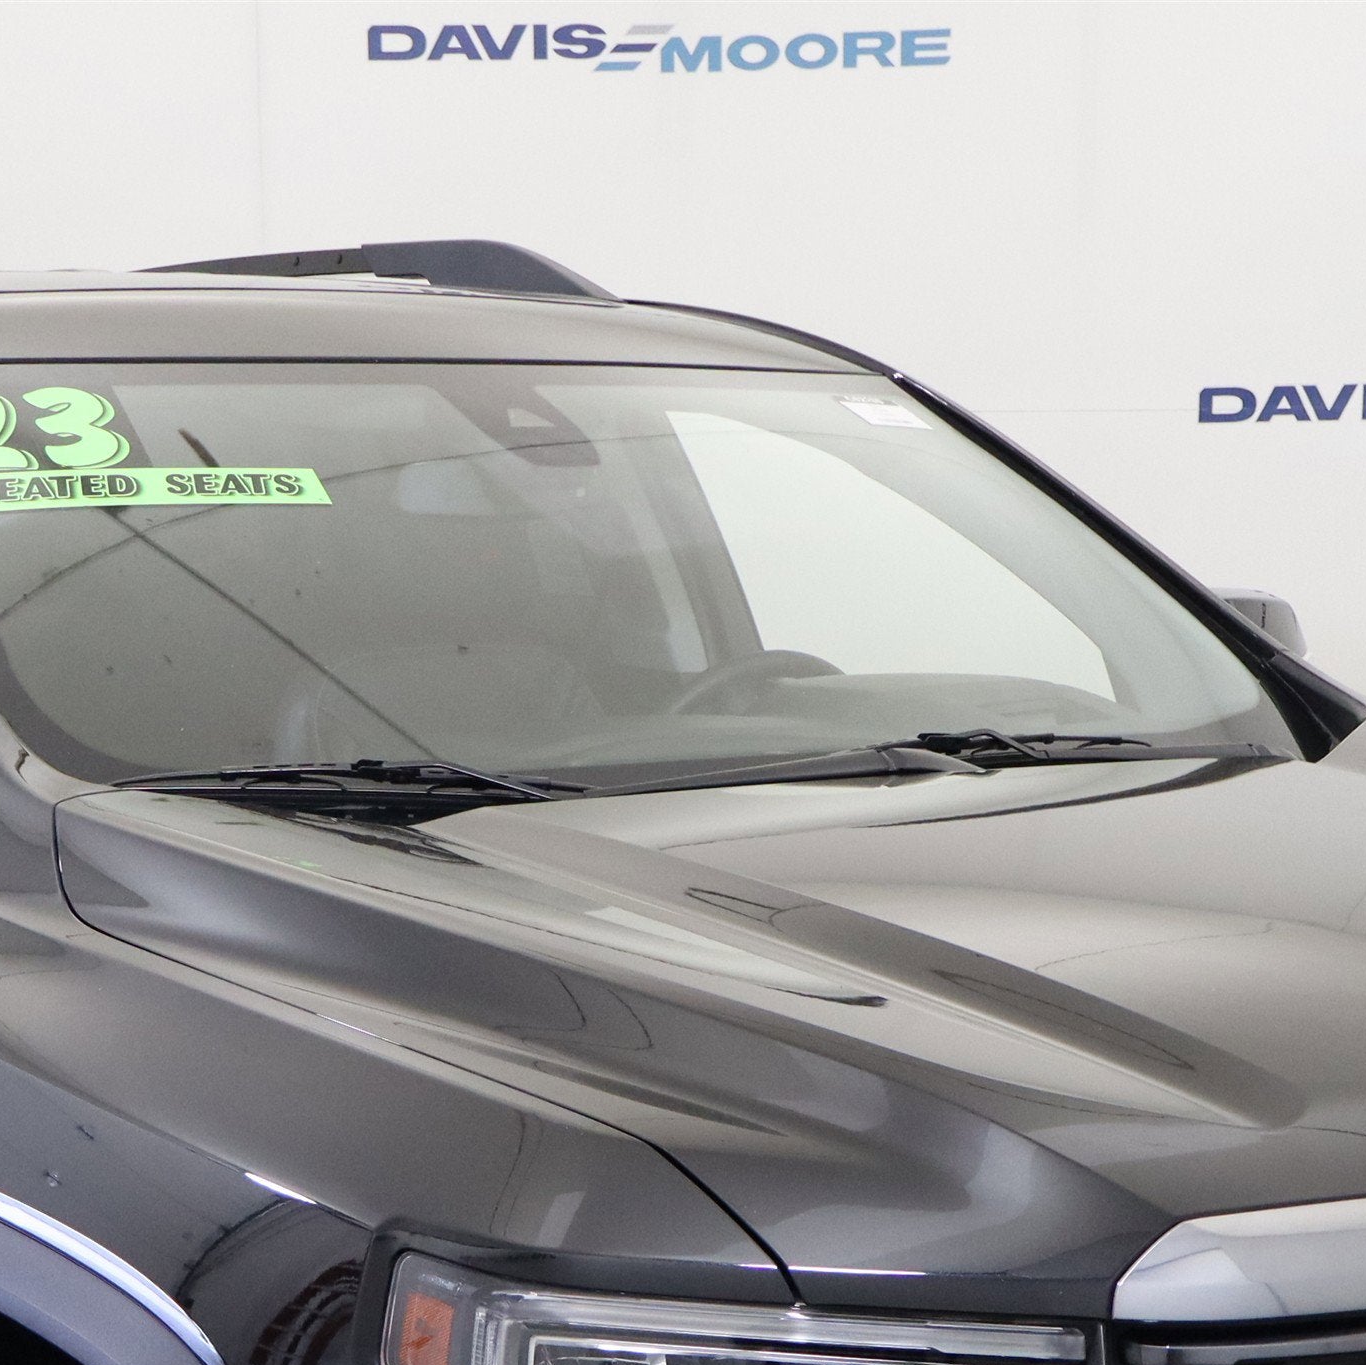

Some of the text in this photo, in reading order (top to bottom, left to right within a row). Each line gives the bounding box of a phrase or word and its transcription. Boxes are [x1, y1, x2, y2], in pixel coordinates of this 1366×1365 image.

[367, 23, 952, 73] DAVIS MOORE
[165, 473, 304, 497] SEATS
